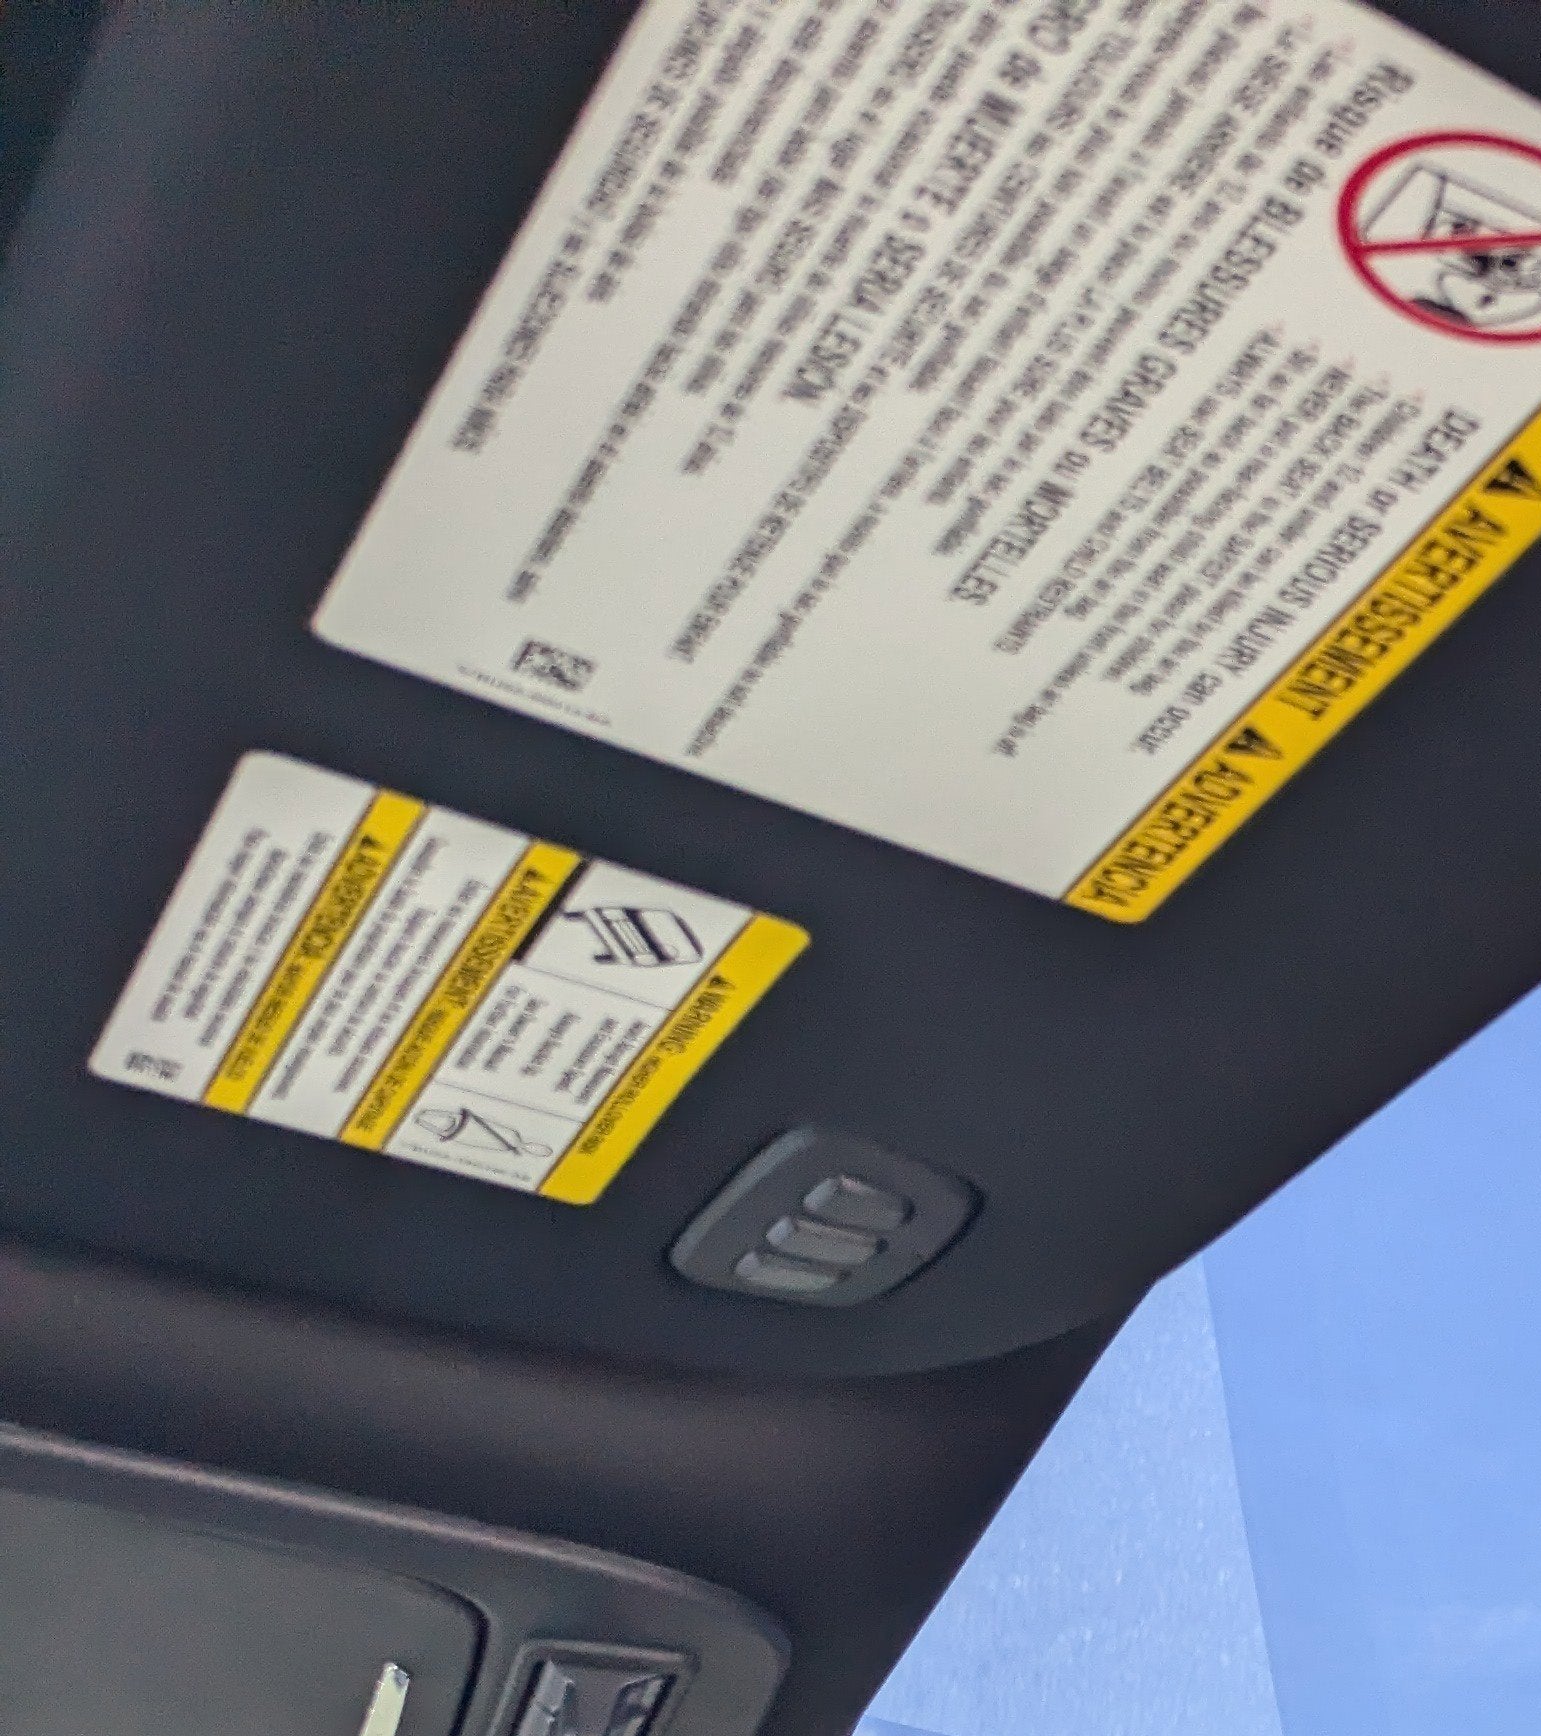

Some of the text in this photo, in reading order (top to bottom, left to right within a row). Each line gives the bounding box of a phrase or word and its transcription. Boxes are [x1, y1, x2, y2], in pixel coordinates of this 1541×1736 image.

[1304, 53, 1418, 164] Risque
[1277, 154, 1337, 201] de
[1151, 191, 1308, 356] BLESSURES
[1072, 348, 1181, 454] GRAVES
[1383, 406, 1483, 493] DEATH
[1047, 446, 1092, 480] ou
[1360, 485, 1400, 514] or
[1273, 512, 1384, 609] SERIOUS
[1210, 603, 1296, 675] INJURY
[1269, 501, 1517, 721] AVERTISSEMENT
[1176, 670, 1224, 706] can
[1076, 756, 1259, 911] ADVERTENCIA
[295, 851, 381, 964] ADVERTENCIA
[438, 882, 542, 1010] AVERTISSEMENT
[654, 988, 726, 1057] WARNING
